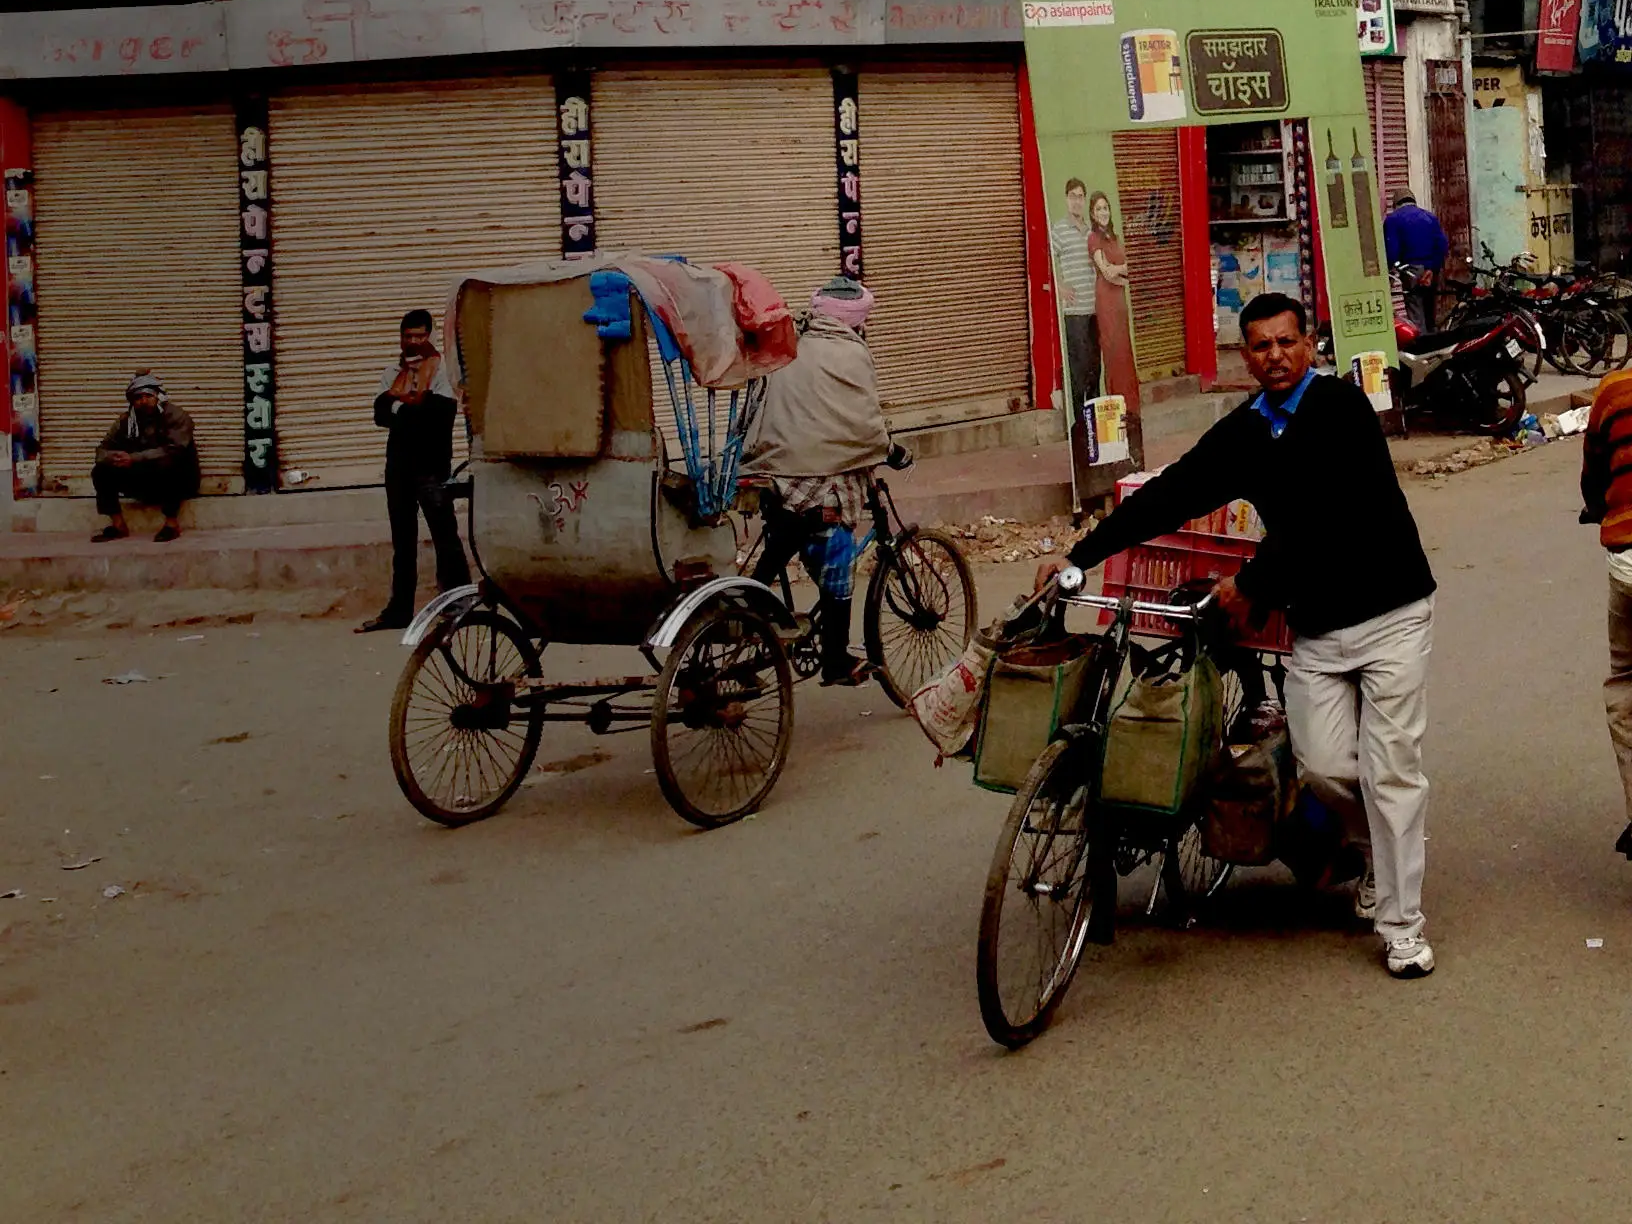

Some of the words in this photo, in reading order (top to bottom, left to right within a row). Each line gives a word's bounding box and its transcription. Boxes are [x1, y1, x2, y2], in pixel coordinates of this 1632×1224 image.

[1050, 2, 1113, 19] asianpaints
[1138, 39, 1172, 51] TRACTOR
[1202, 37, 1268, 59] समझदार
[1122, 42, 1138, 113] asianpaints
[1207, 60, 1271, 105] चॉइस
[1473, 77, 1501, 91] PER
[1366, 299, 1383, 315] 1.5
